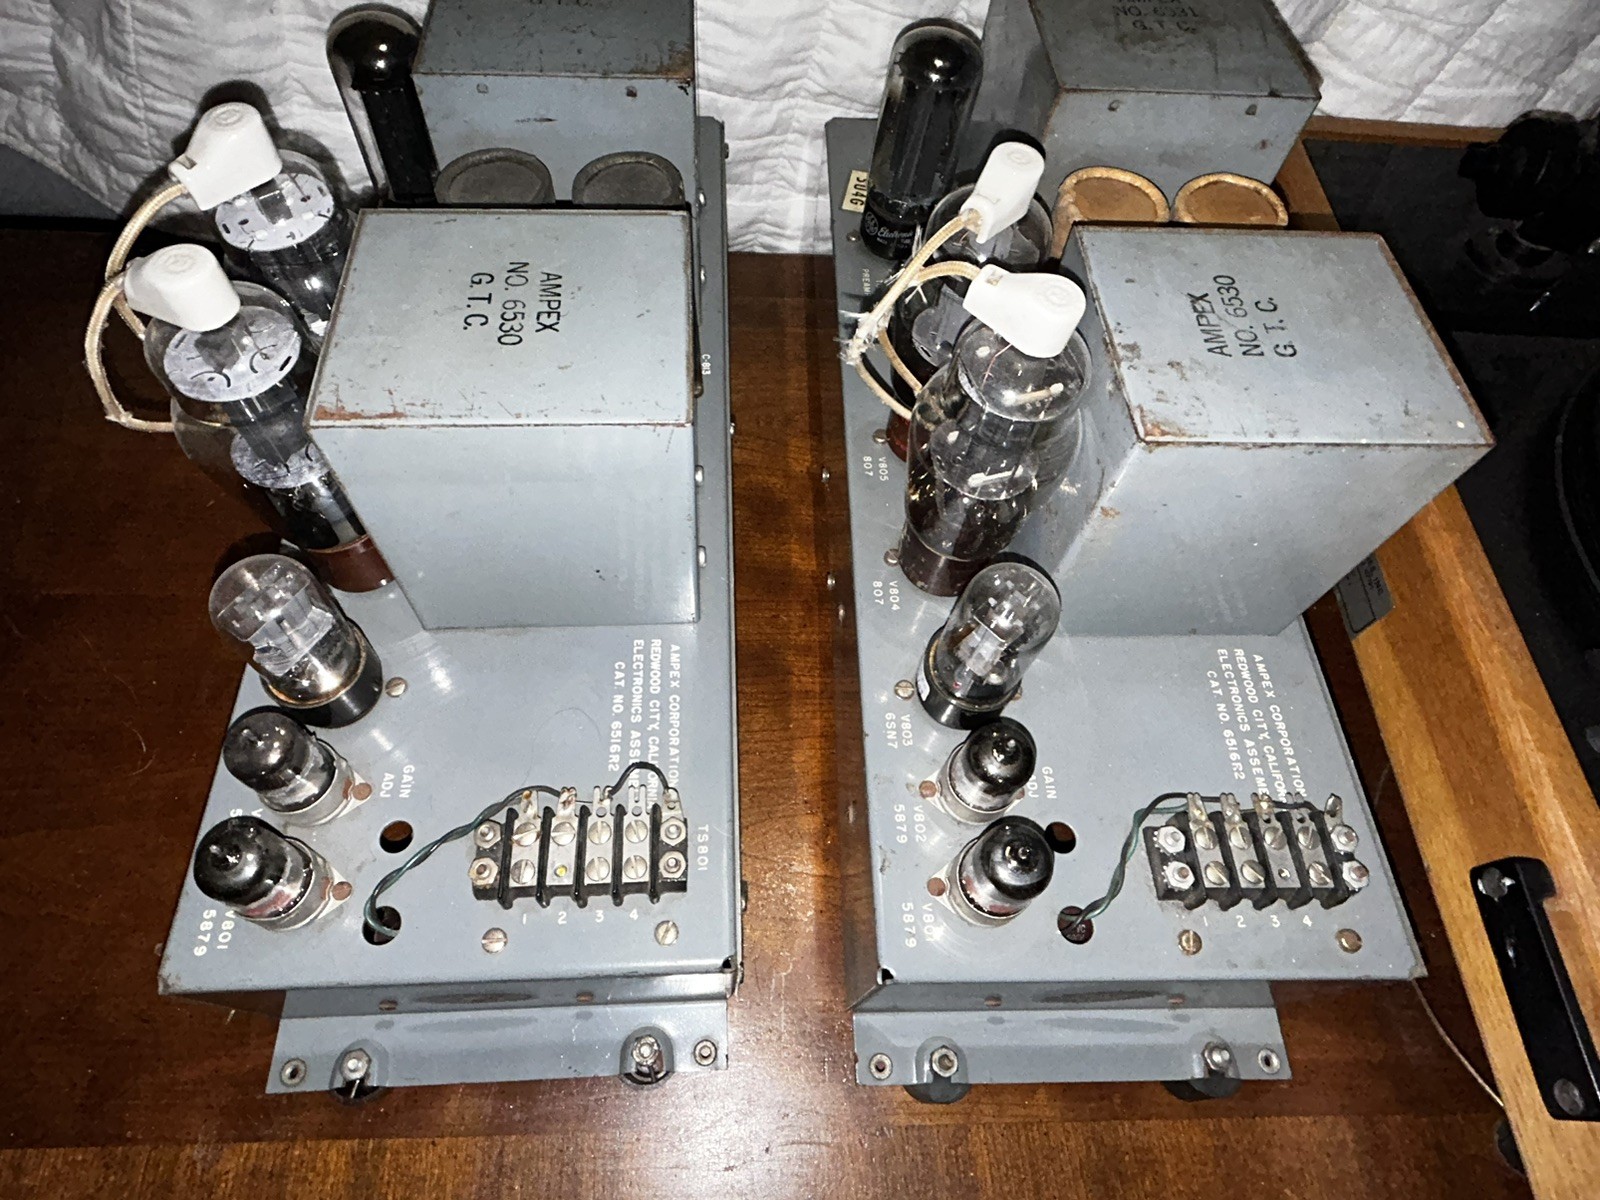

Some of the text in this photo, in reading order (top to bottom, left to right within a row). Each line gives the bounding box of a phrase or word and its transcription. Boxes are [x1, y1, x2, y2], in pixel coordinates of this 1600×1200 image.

[497, 261, 530, 346] NO. 6530
[535, 271, 563, 333] AMPEX
[1212, 274, 1265, 357] NO. 6530
[1186, 292, 1233, 358] AMPEX
[862, 455, 874, 478] 807
[878, 455, 890, 483] V805
[872, 580, 885, 606] 807
[889, 580, 901, 612] V804
[630, 639, 645, 723] ELECTRONICS
[649, 638, 662, 695] REDWOOD
[669, 644, 681, 689] AMPEX
[1233, 648, 1259, 704] REDWOOD
[611, 694, 625, 717] NO.
[1217, 648, 1251, 733] ELECTRONICS
[884, 711, 899, 750] 6SN7
[900, 713, 914, 748] V803
[1216, 702, 1231, 725] NO.
[1252, 653, 1308, 797] AMPEX CORPORATION
[607, 721, 623, 772] 6516R2
[1223, 729, 1246, 780] 6516R2
[380, 772, 395, 798] ADJ
[399, 764, 416, 799] GAIN
[1041, 766, 1058, 799] GAIN
[894, 803, 908, 845] 5879
[913, 804, 928, 843] V802
[697, 823, 709, 871] TS801
[193, 908, 218, 957] 5879
[216, 909, 237, 950] V801
[522, 908, 640, 925] 1 2 3 4
[901, 901, 918, 949] 5879
[1202, 914, 1313, 929] 1 2 3 4
